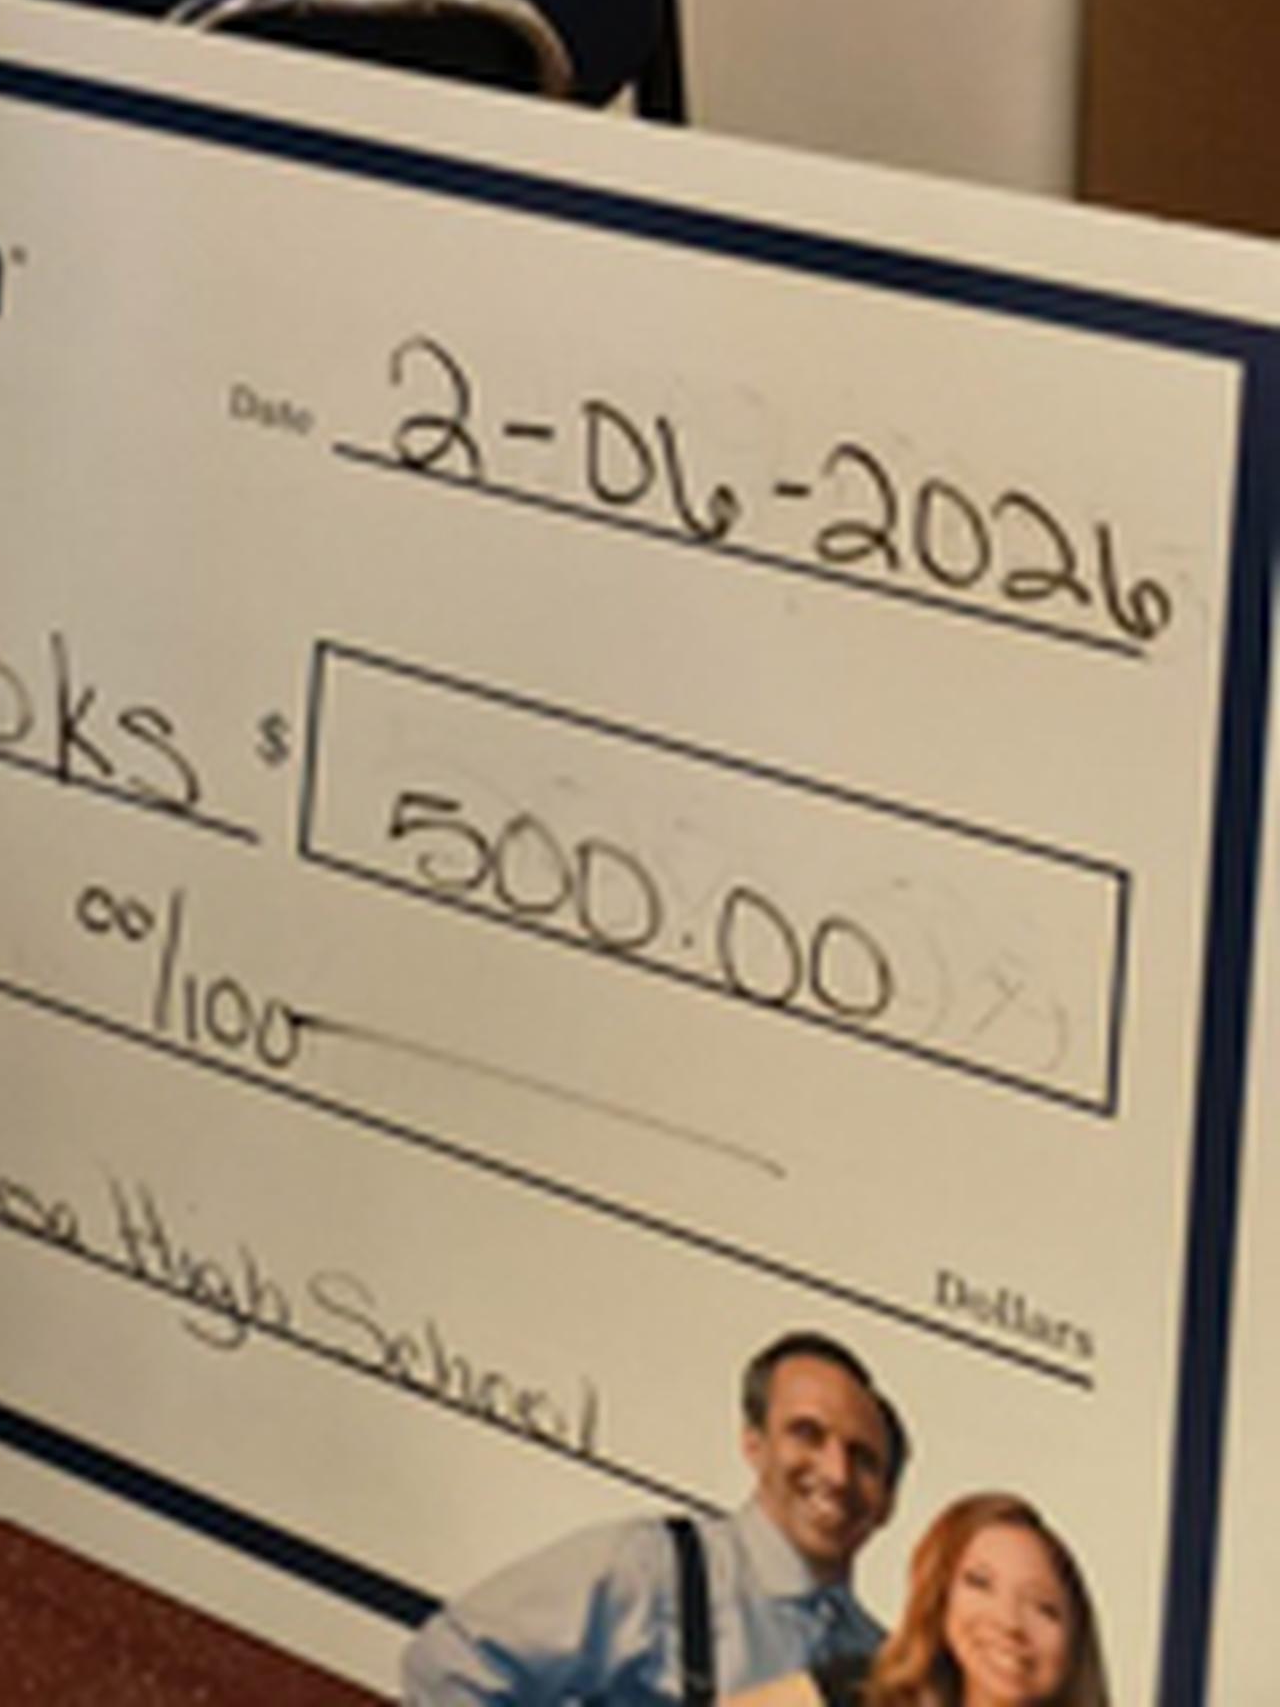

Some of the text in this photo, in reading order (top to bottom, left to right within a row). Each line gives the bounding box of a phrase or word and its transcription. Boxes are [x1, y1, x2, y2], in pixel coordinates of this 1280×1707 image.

[229, 382, 317, 438] Date
[391, 336, 1172, 645] 2-06-2026
[257, 710, 291, 766] $
[387, 792, 895, 1020] 500.00
[108, 1169, 293, 1351] High
[308, 1269, 601, 1457] School
[934, 1269, 1097, 1360] Dollars
